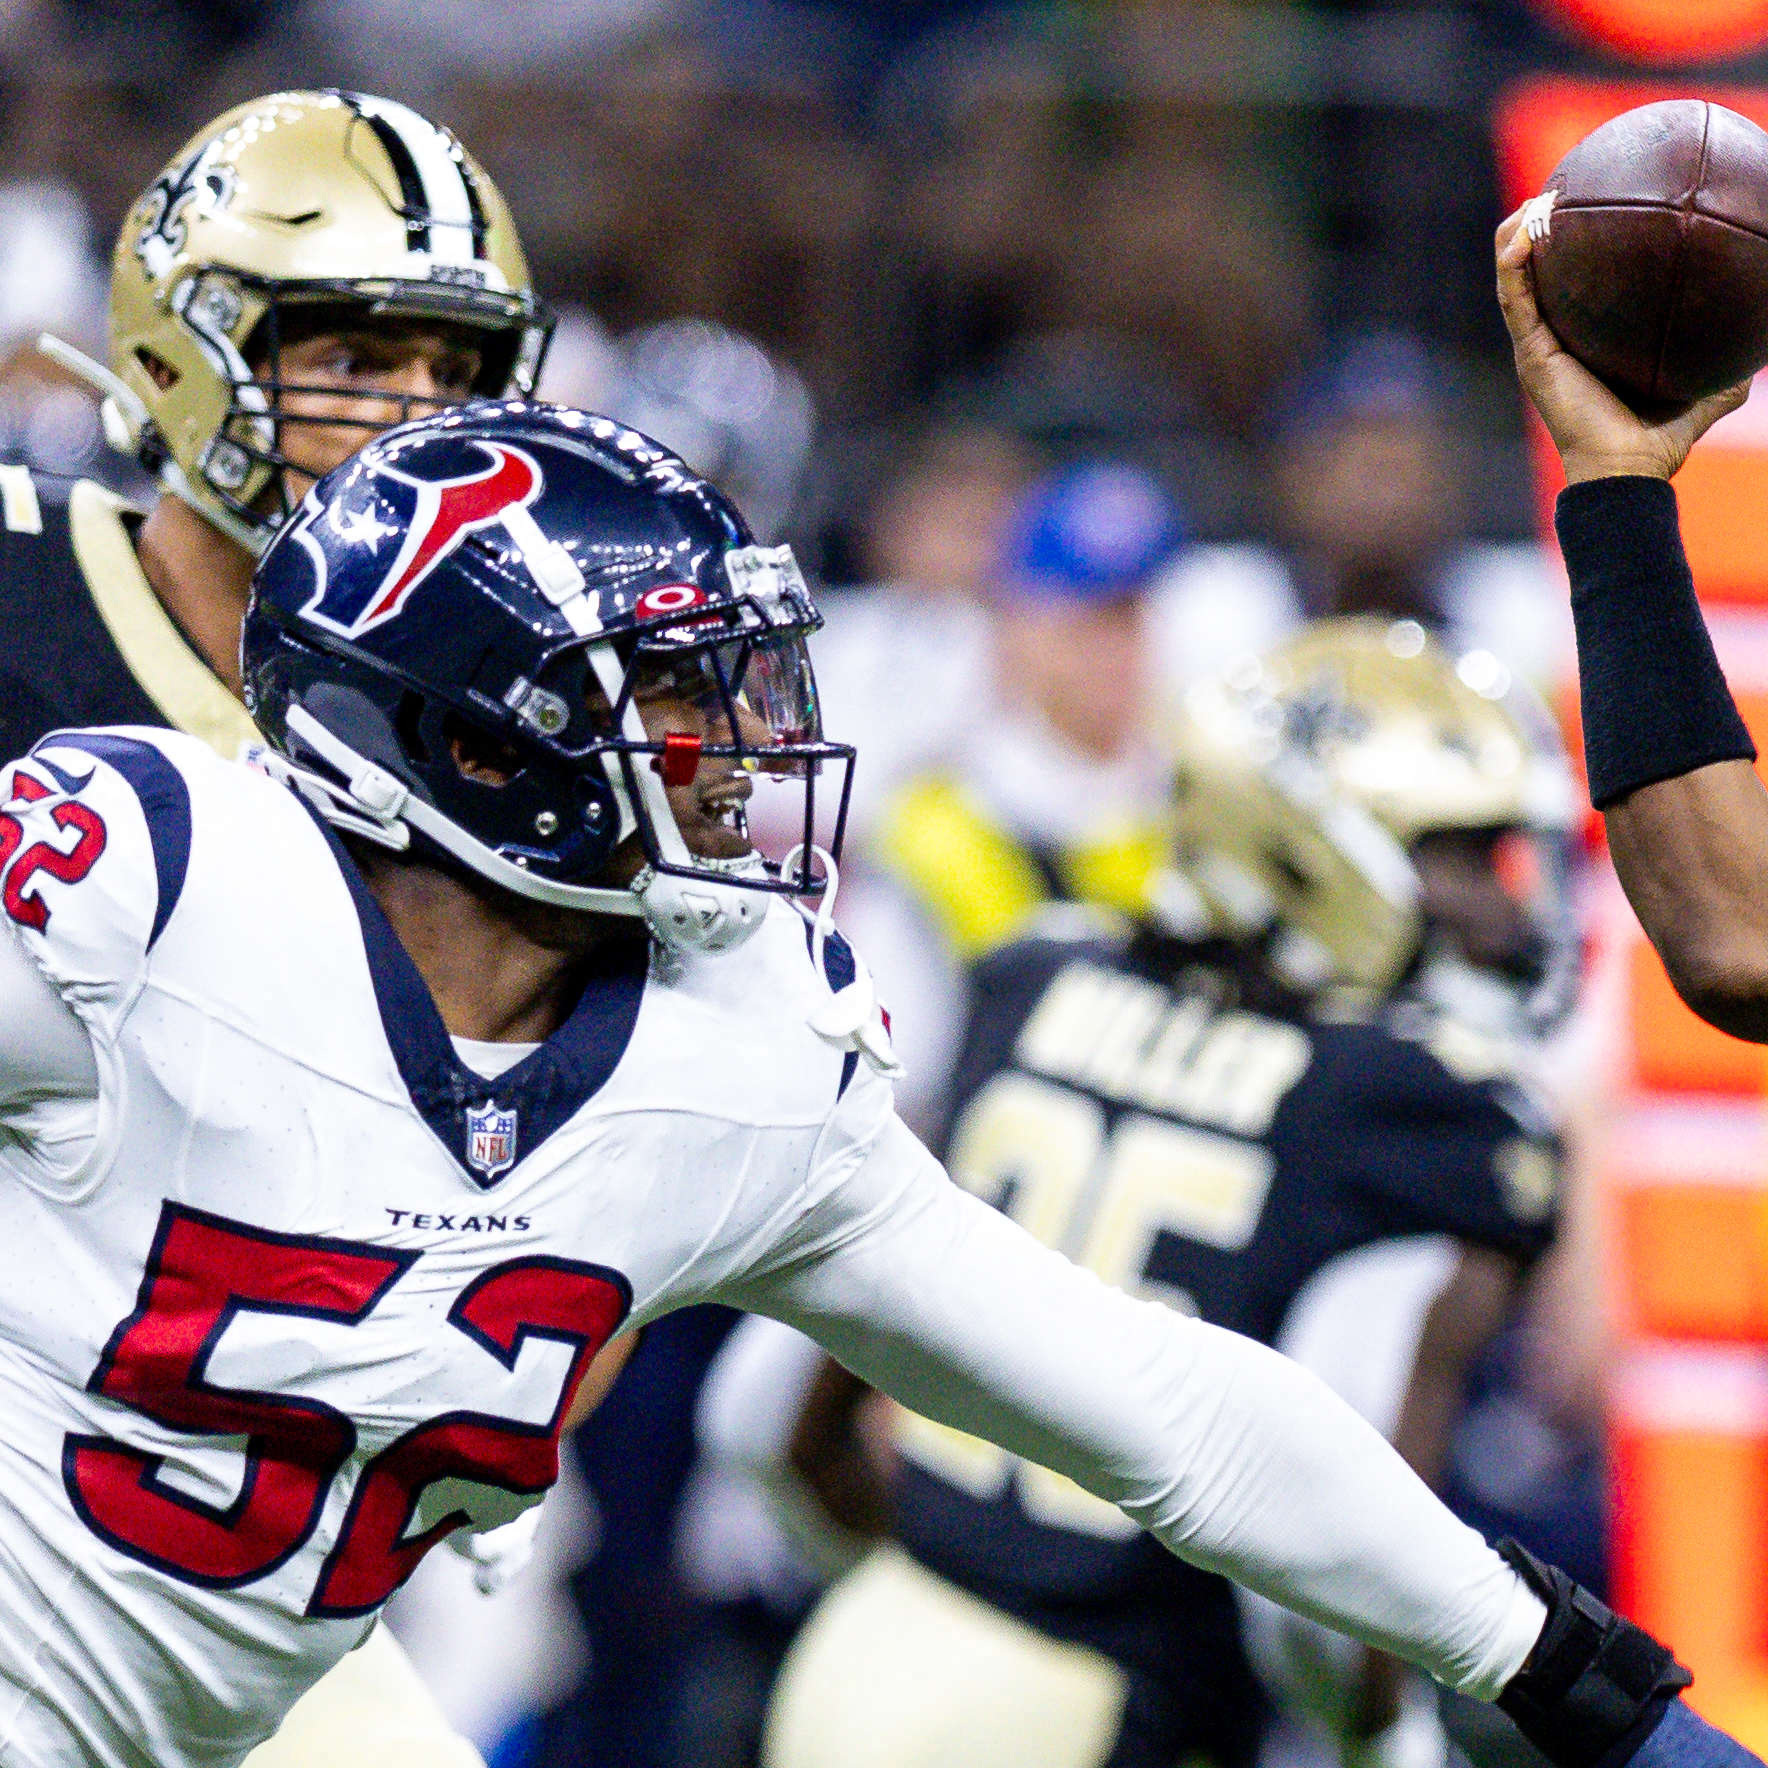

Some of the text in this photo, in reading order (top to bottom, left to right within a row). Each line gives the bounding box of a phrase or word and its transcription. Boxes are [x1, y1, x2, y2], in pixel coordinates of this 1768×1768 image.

[475, 1135, 509, 1163] NFL
[385, 1207, 532, 1233] TEXANS
[62, 1199, 635, 1620] 52
